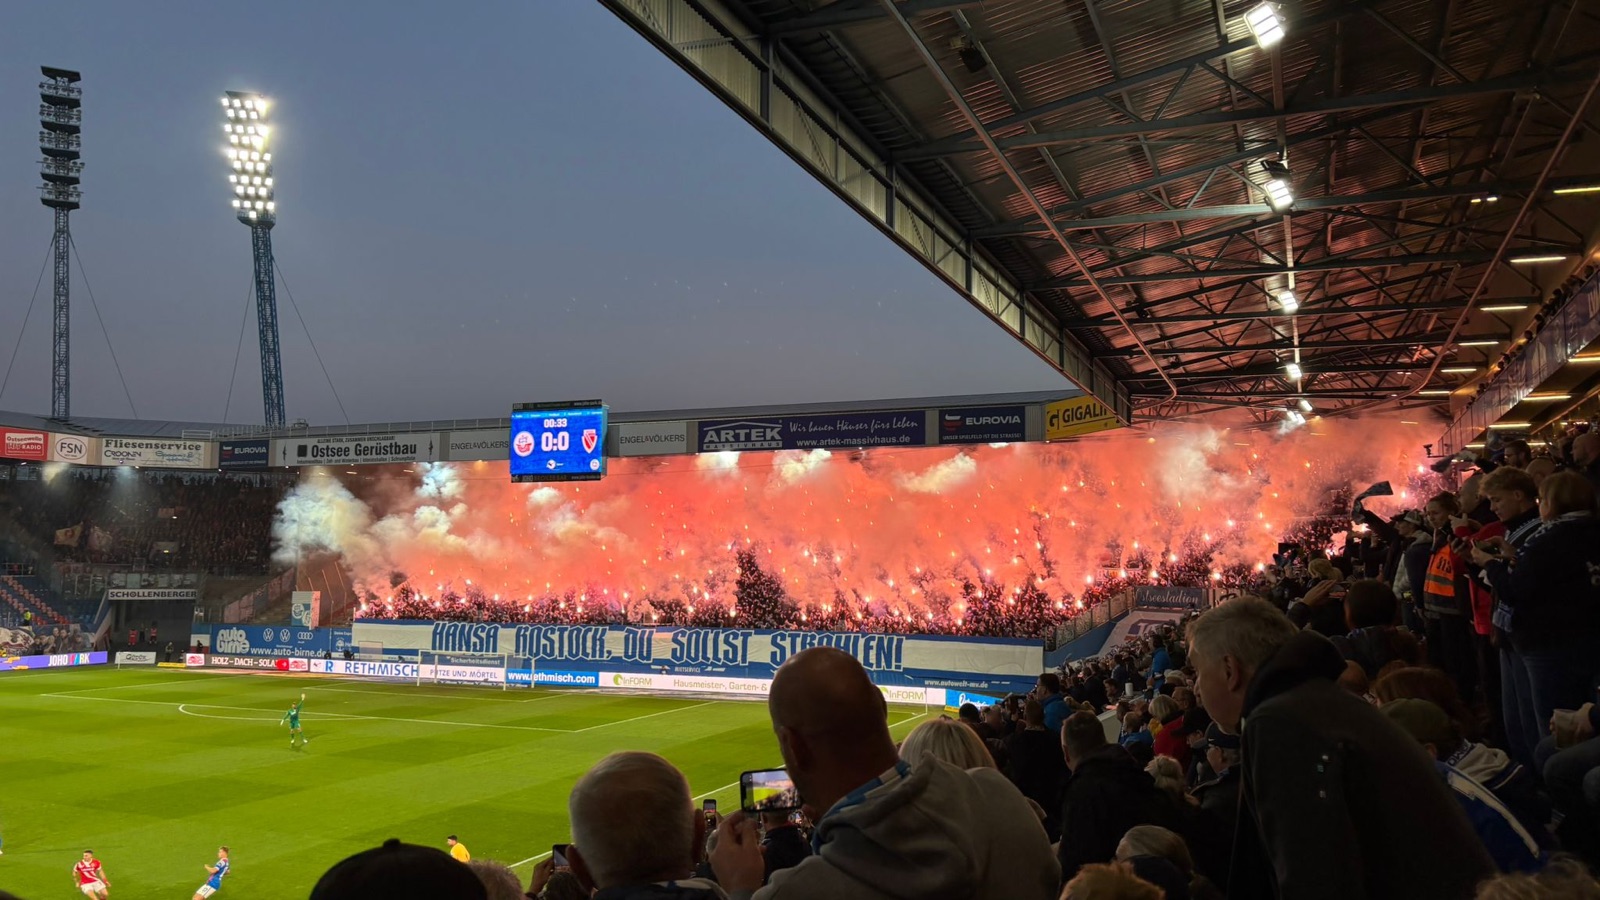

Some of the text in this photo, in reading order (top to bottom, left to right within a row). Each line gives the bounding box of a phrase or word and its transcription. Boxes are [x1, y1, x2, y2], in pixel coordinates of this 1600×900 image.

[544, 418, 568, 428] 00:33
[790, 417, 918, 432] Wir bauen Häuser fürs Leben
[966, 415, 1020, 426] EUROVIA
[620, 434, 685, 444] ENGEL&VÖLKERS
[704, 428, 782, 442] ARTEK
[796, 434, 910, 446] www.artek-massivhaus.de
[104, 440, 202, 451] Fliesenservice
[451, 440, 508, 450] ENGEL&VÖLKERS
[541, 432, 570, 452] 0:0
[60, 442, 82, 454] FSN
[234, 446, 267, 454] EUROVIA
[311, 442, 416, 458] Ostsee Gerüstbau
[110, 590, 197, 598] SCHOLLENBERGER
[432, 621, 500, 654] HANSA
[514, 624, 613, 660] ROSTOCK,
[622, 626, 656, 664] DU
[670, 628, 754, 666] SOLLST
[250, 648, 326, 658] www.auto-birne.de
[48, 655, 68, 666] JOHO
[212, 657, 229, 665] HOLZ
[234, 658, 253, 666] DACH
[345, 662, 418, 677] RETHMISCH
[469, 670, 498, 678] MÖRTEL
[622, 676, 652, 686] InFORM
[728, 682, 759, 691] Garten-
[889, 689, 924, 700] InFORM
